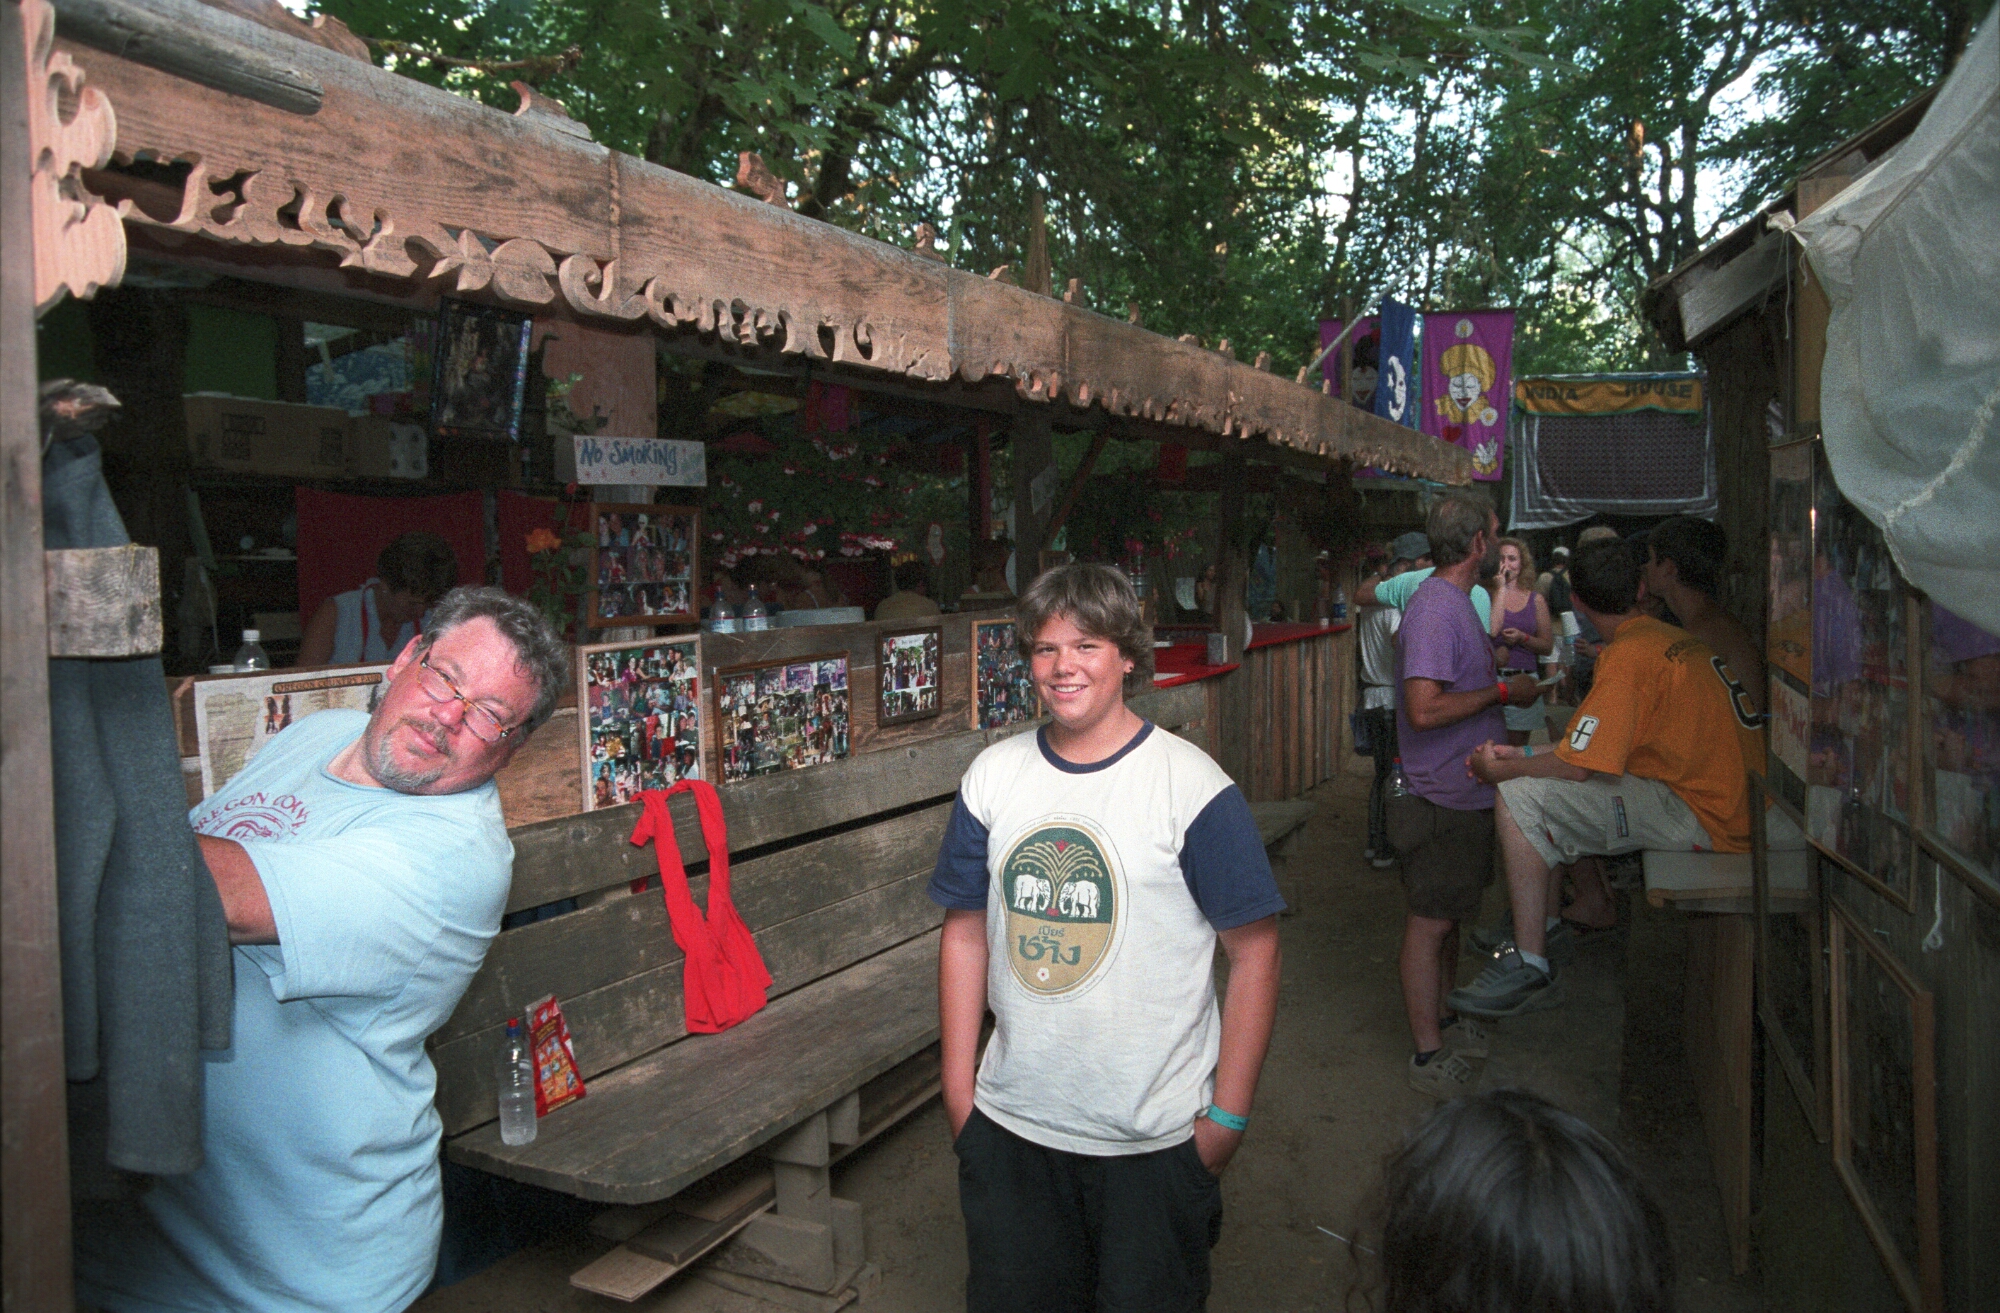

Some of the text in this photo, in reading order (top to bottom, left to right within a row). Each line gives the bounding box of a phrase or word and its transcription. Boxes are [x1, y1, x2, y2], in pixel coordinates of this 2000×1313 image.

[1525, 381, 1693, 401] INDIA HOUSE
[1038, 925, 1065, 938] เบียร์
[1017, 935, 1082, 966] ช้าง
